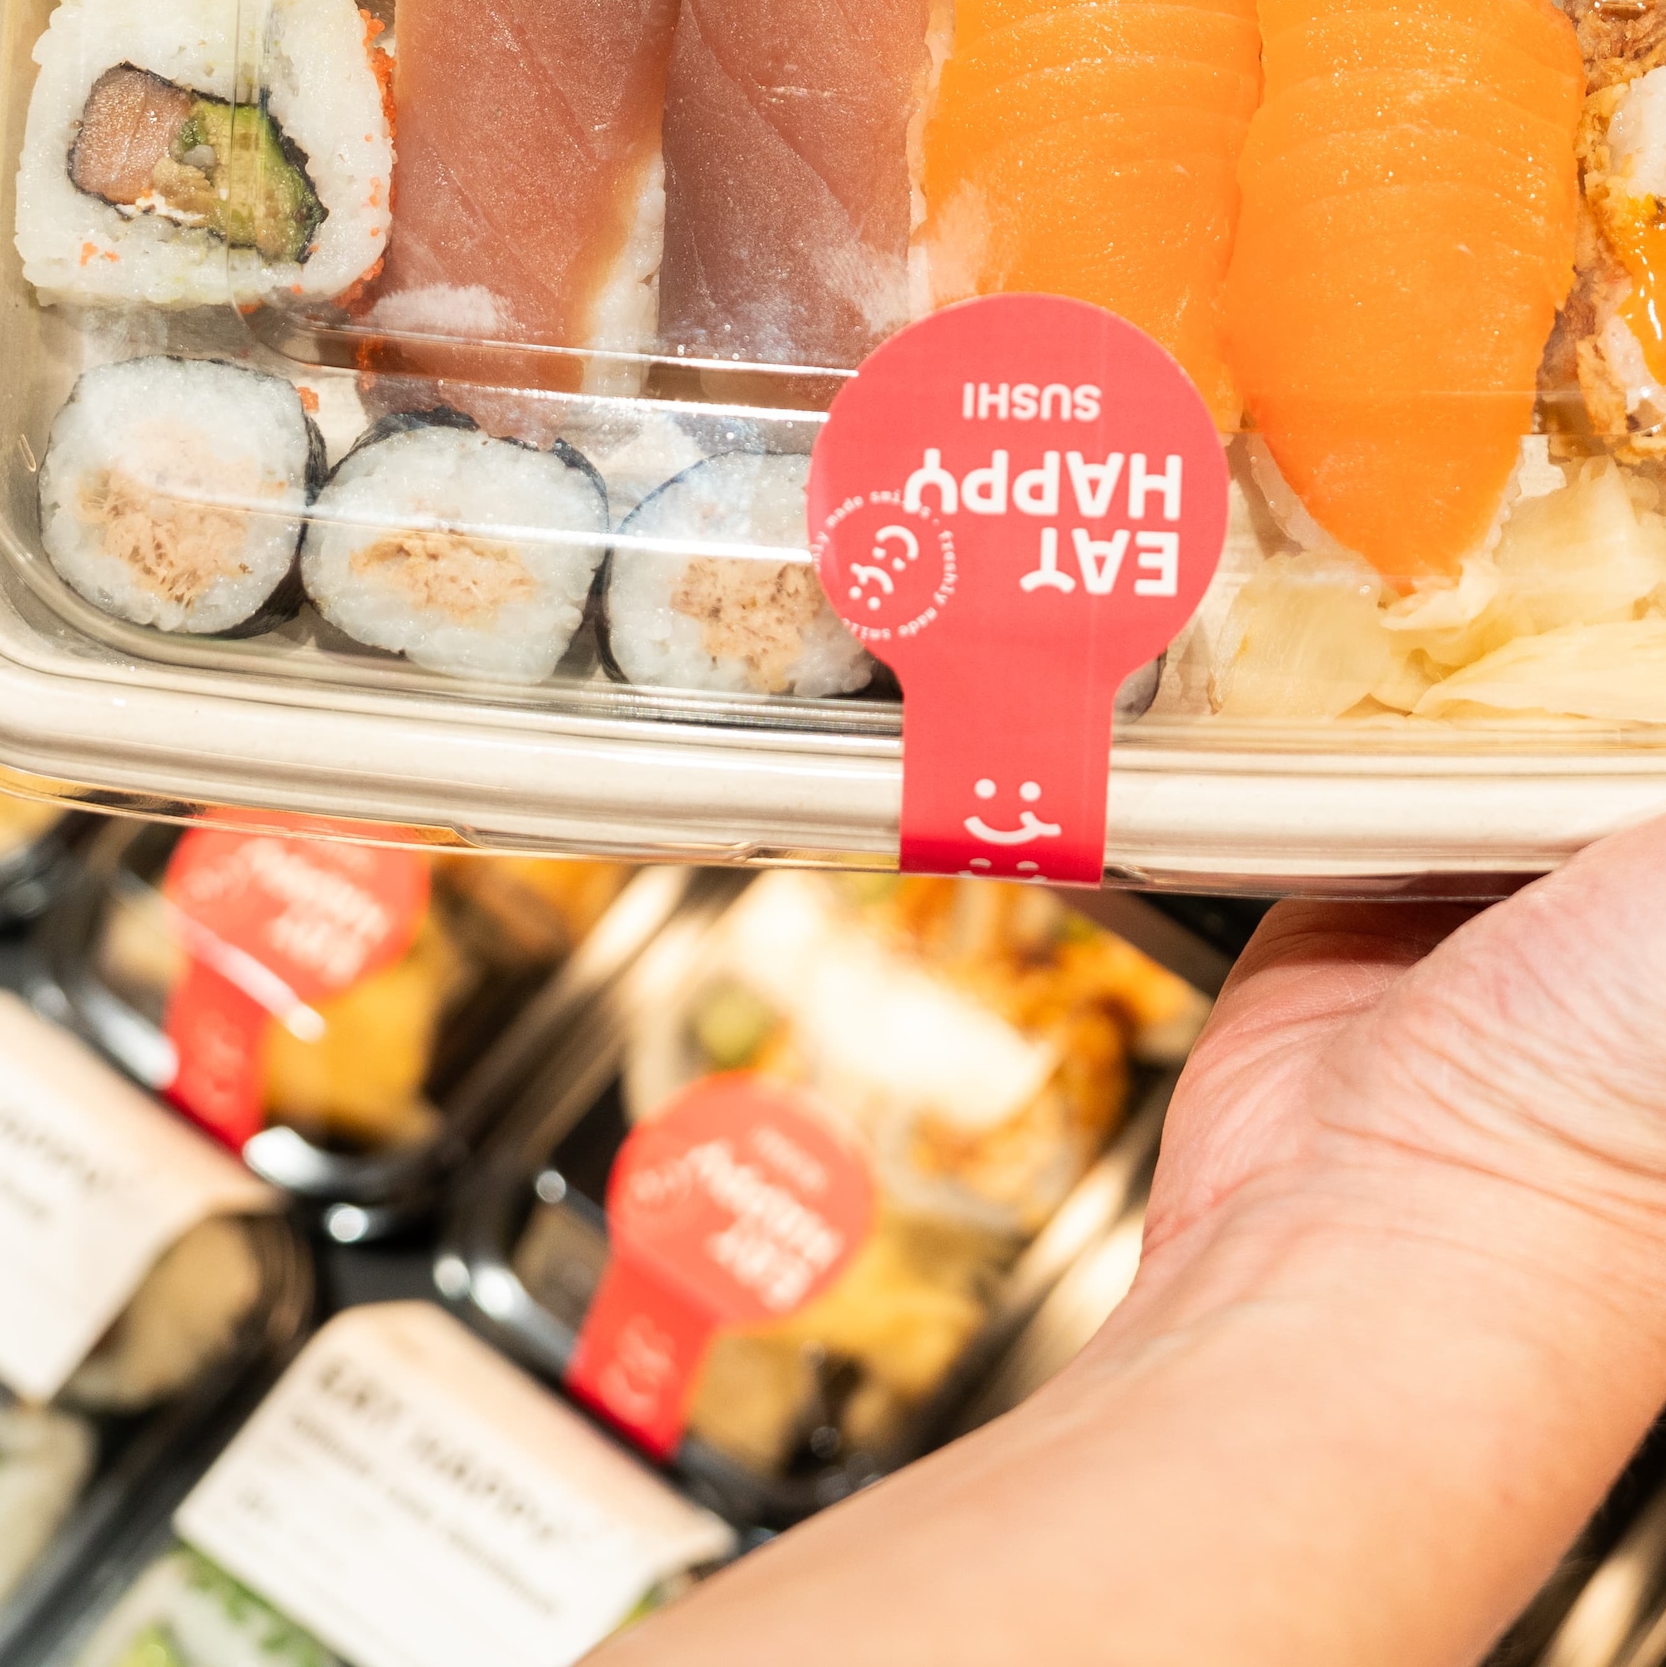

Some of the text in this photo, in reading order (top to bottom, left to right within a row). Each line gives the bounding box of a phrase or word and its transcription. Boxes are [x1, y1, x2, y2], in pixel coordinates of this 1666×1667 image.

[962, 382, 1102, 422] SUSHI
[903, 447, 1183, 521] HAPPY
[1019, 527, 1180, 596] EAT
